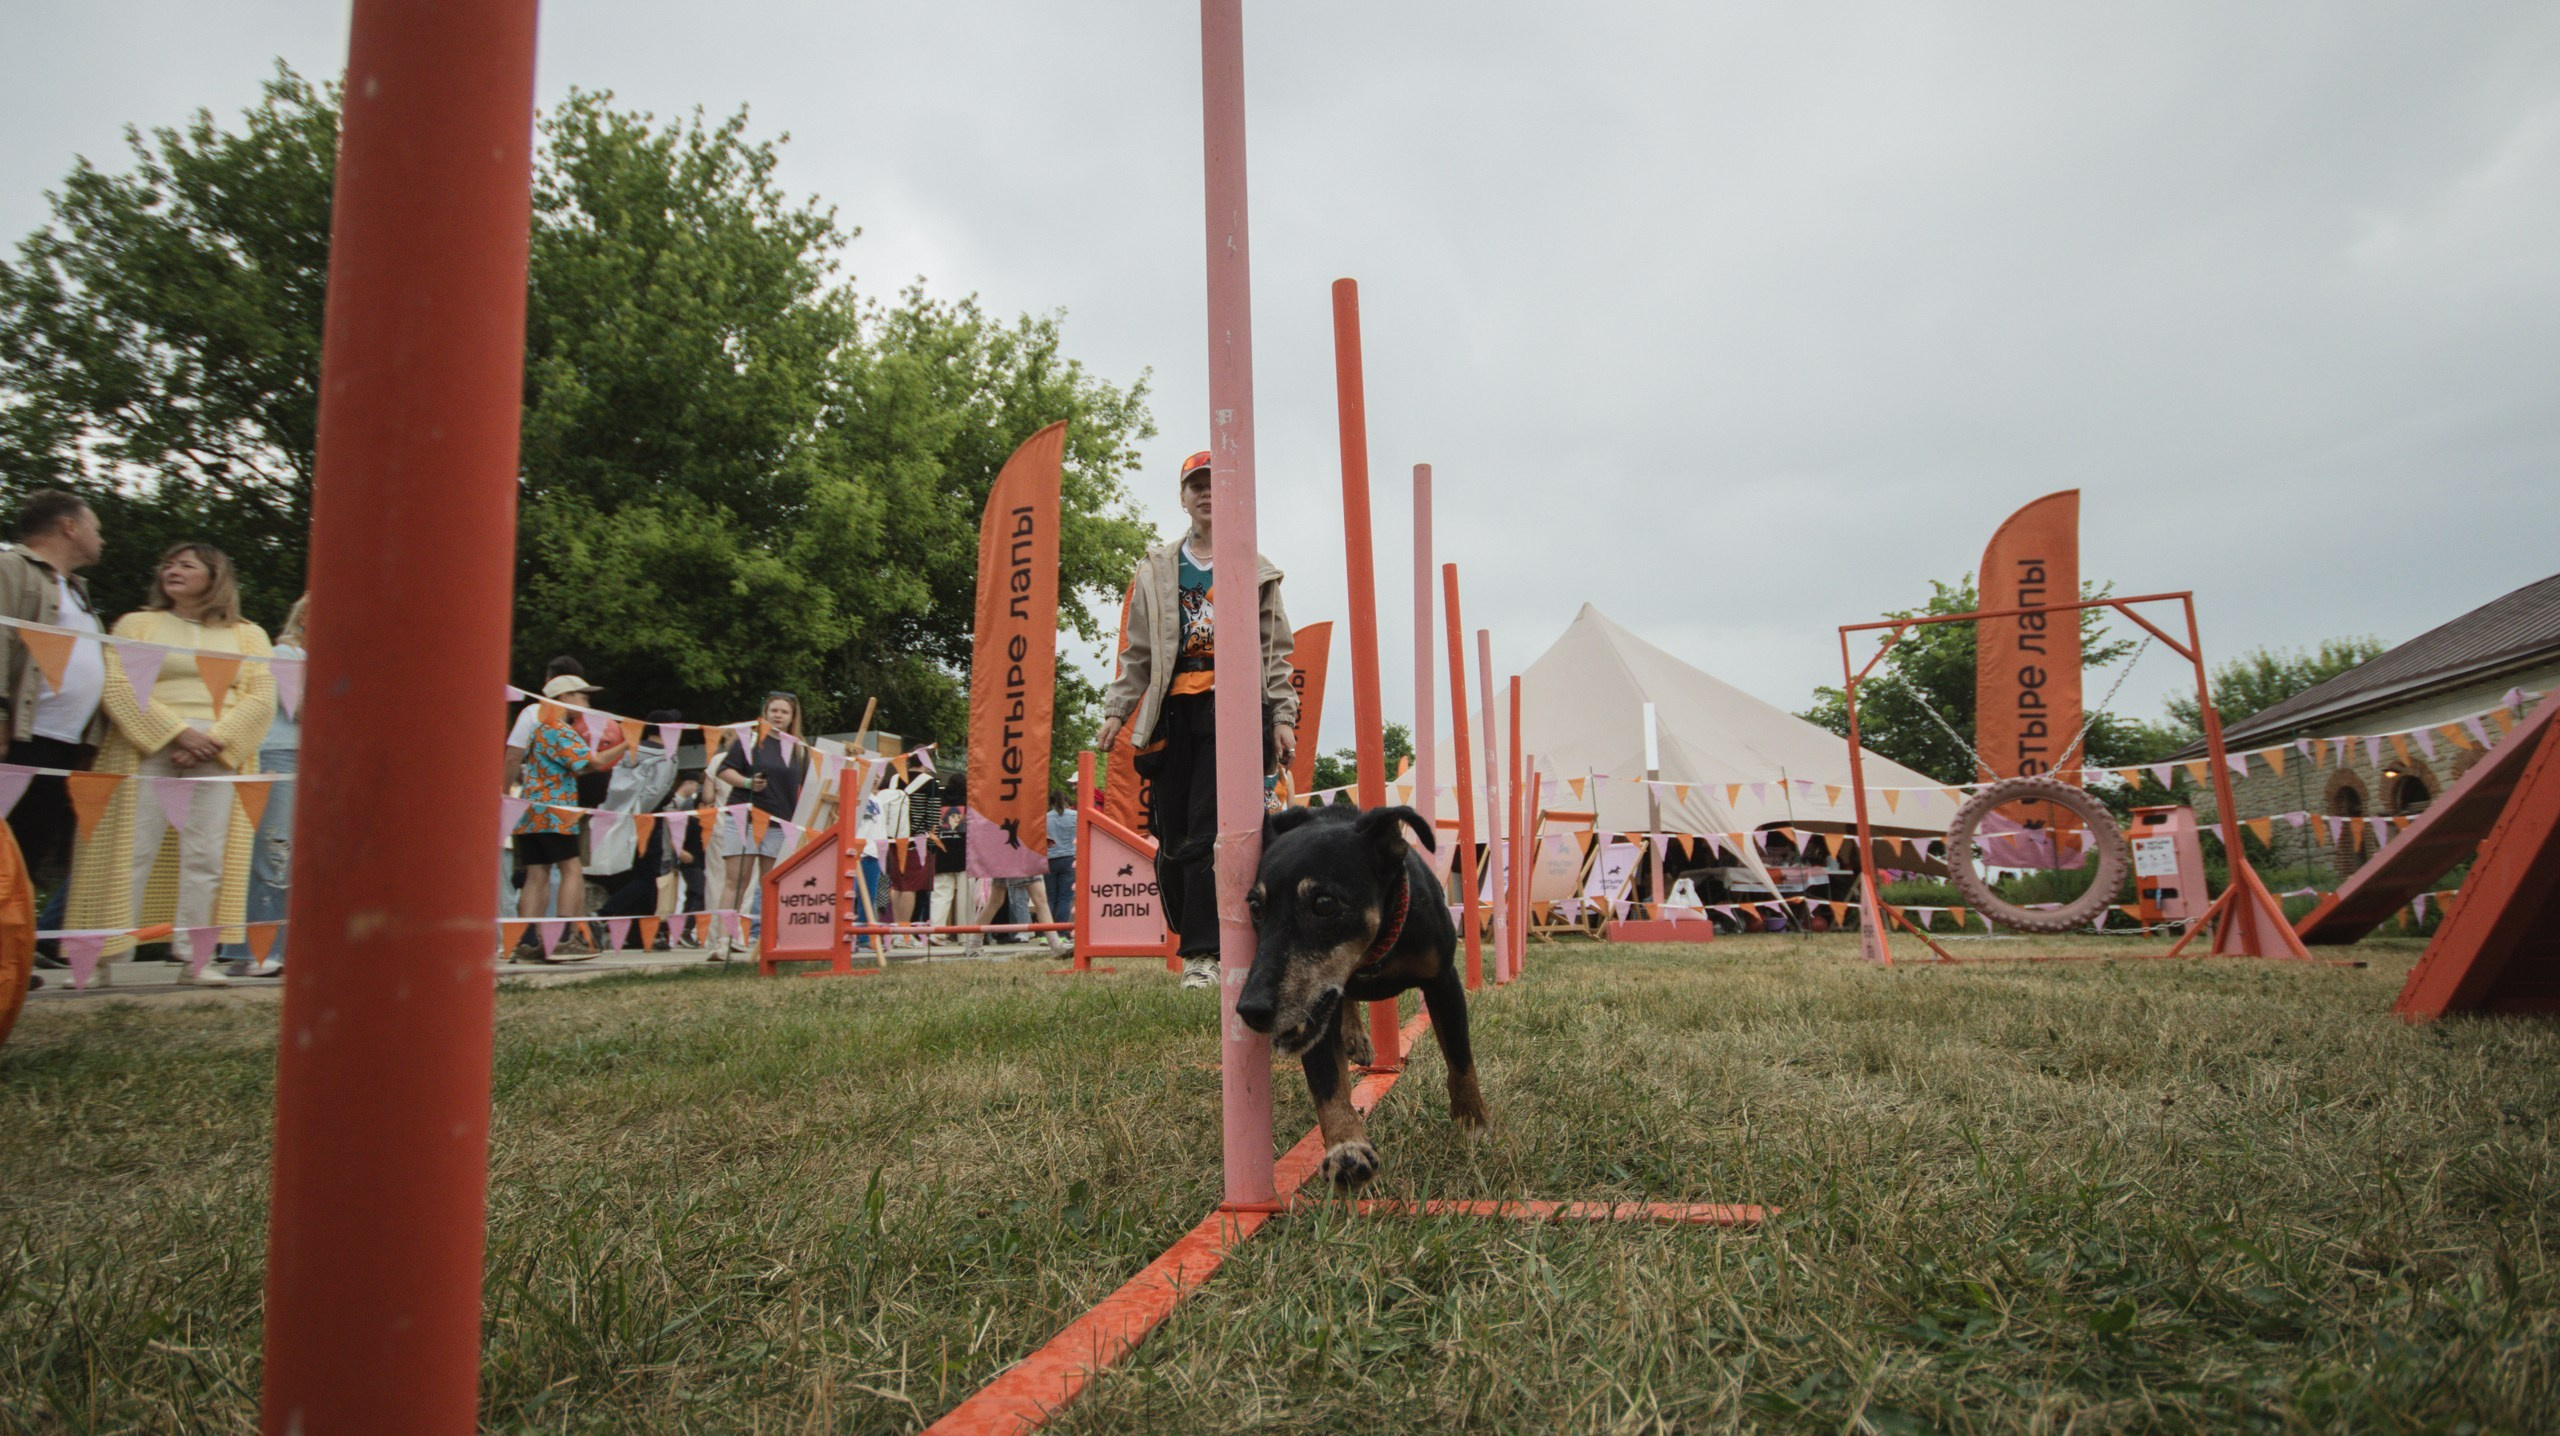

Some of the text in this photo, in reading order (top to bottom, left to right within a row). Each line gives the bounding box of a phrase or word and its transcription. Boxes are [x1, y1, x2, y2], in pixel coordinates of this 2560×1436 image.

[2017, 559, 2049, 656] лапы
[1000, 505, 1035, 802] четыре лапы
[1090, 882, 1160, 898] четыре
[780, 893, 837, 907] четыре
[1101, 903, 1150, 918] лапы
[788, 912, 830, 925] лапы
